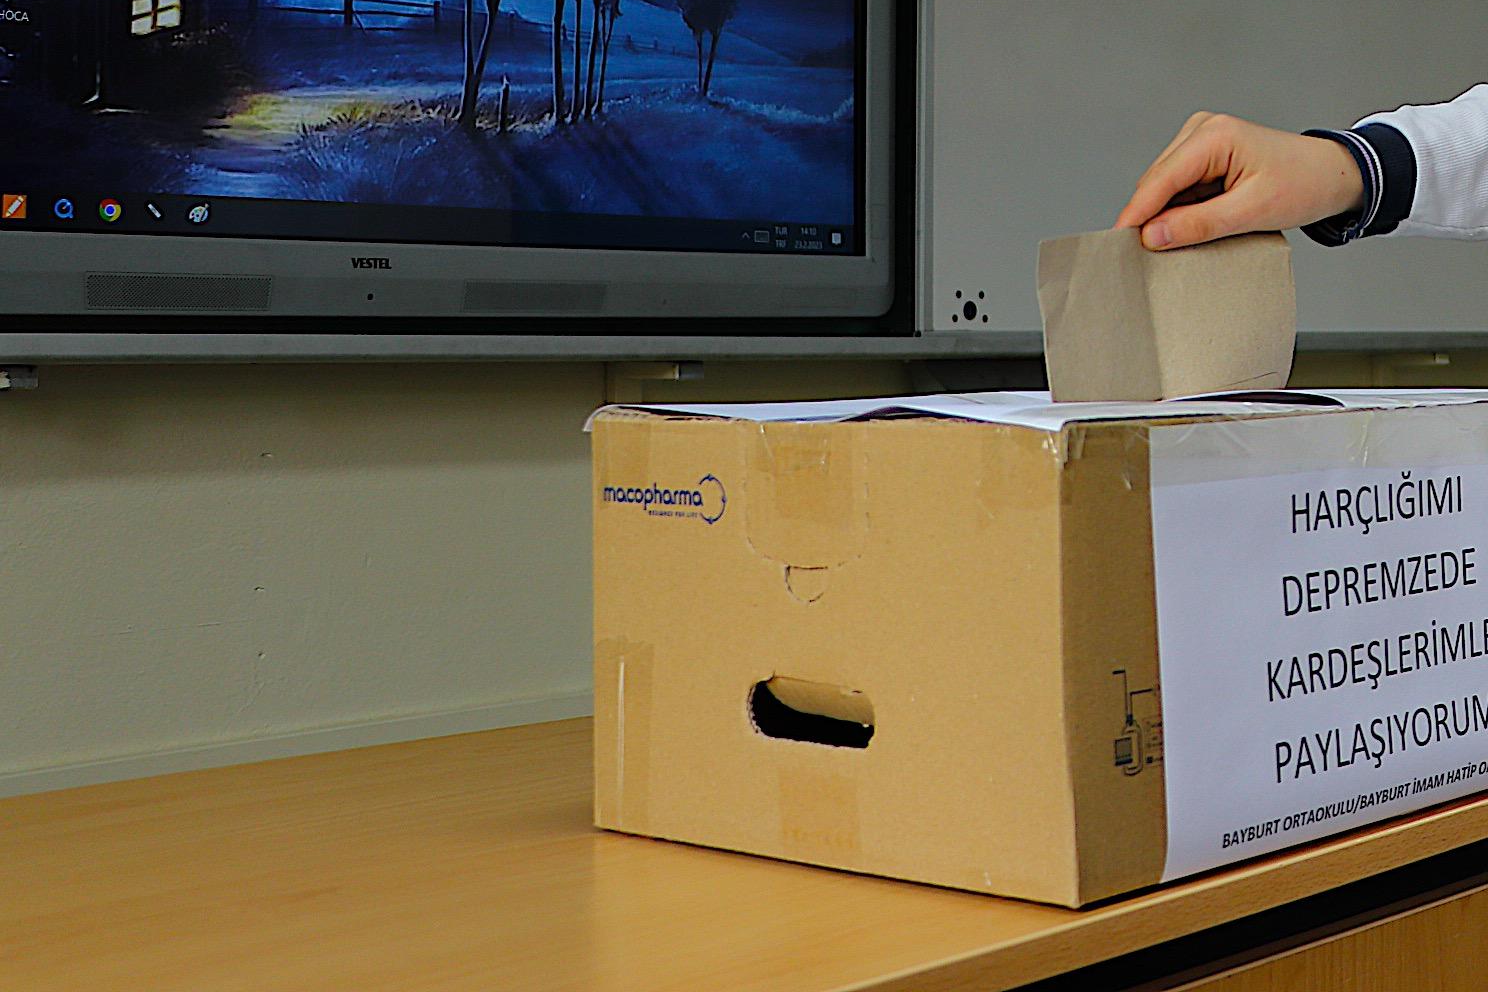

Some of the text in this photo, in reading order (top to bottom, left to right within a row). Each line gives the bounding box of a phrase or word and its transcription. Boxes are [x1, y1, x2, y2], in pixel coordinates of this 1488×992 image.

[351, 257, 392, 270] VESTEL
[603, 481, 703, 511] macopharma
[1290, 470, 1464, 535] HARÇLIĞIMI
[1281, 547, 1478, 617] DEPREMZEDE
[1221, 817, 1282, 850] BAYBURT
[1282, 782, 1411, 832] ORTAOKULU/BAYBURT
[1411, 773, 1445, 796] İMAM
[1445, 761, 1477, 786] HATİP
